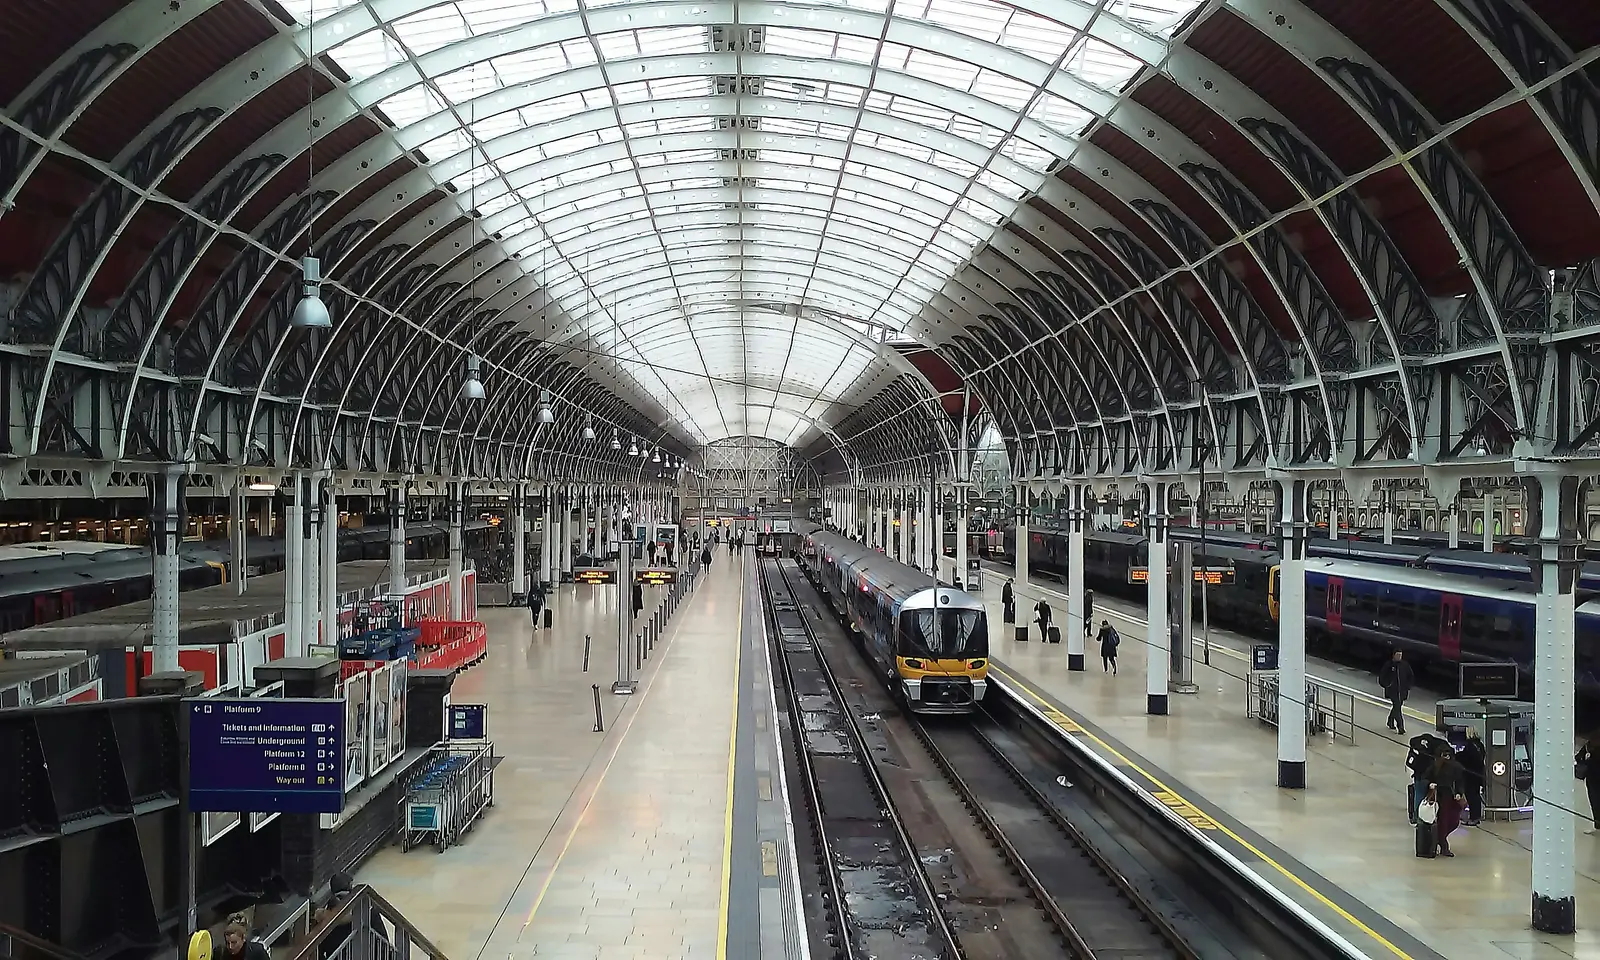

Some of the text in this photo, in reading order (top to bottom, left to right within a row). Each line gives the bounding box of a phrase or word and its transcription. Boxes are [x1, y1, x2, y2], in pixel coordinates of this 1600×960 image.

[224, 705, 262, 714] Platform 9
[222, 723, 306, 732] Tickets and Information
[257, 736, 306, 746] Underground
[264, 749, 305, 758] Platform 12
[268, 762, 299, 771] Platform
[276, 776, 305, 786] Way out
